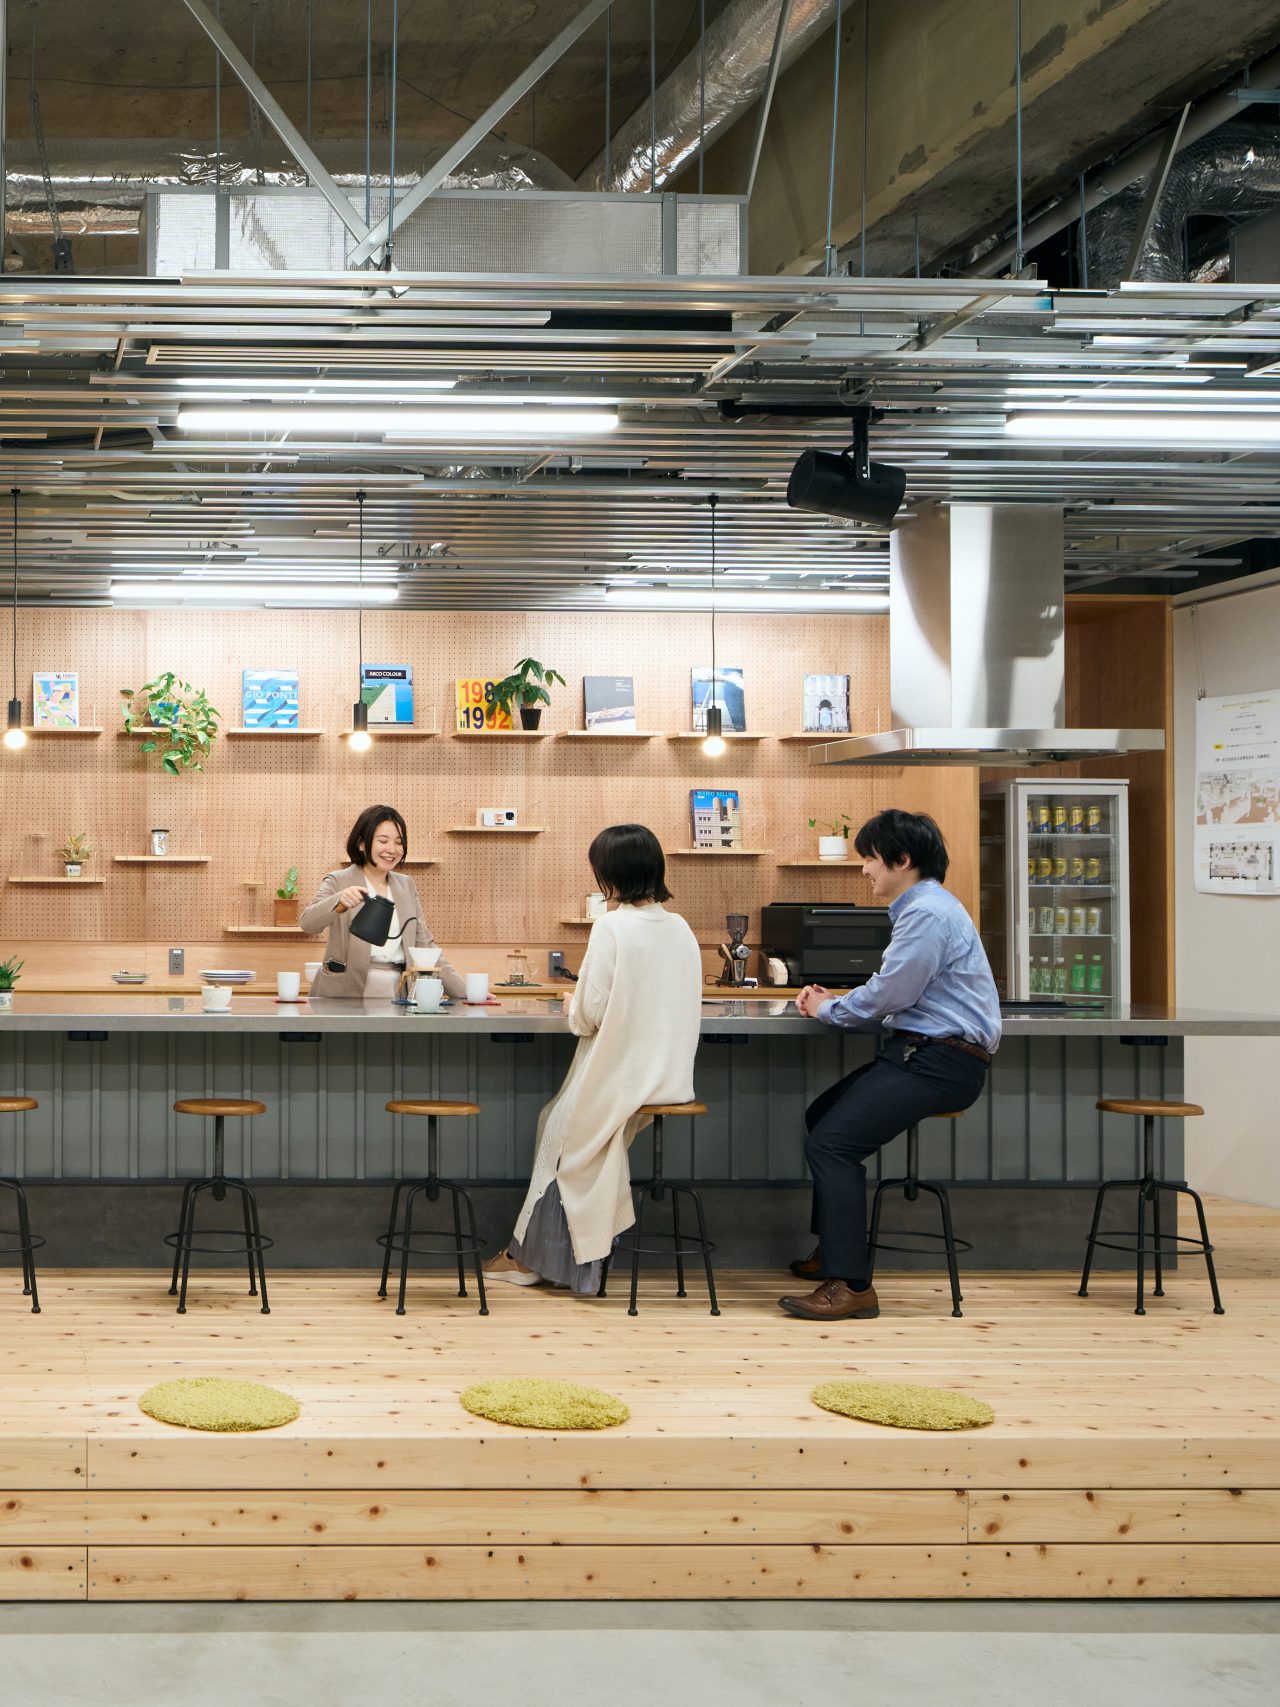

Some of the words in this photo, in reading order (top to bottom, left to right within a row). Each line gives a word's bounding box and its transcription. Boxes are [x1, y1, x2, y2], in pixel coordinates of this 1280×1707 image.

[266, 691, 297, 699] PONTI
[461, 681, 496, 704] 198
[462, 706, 510, 730] 1992
